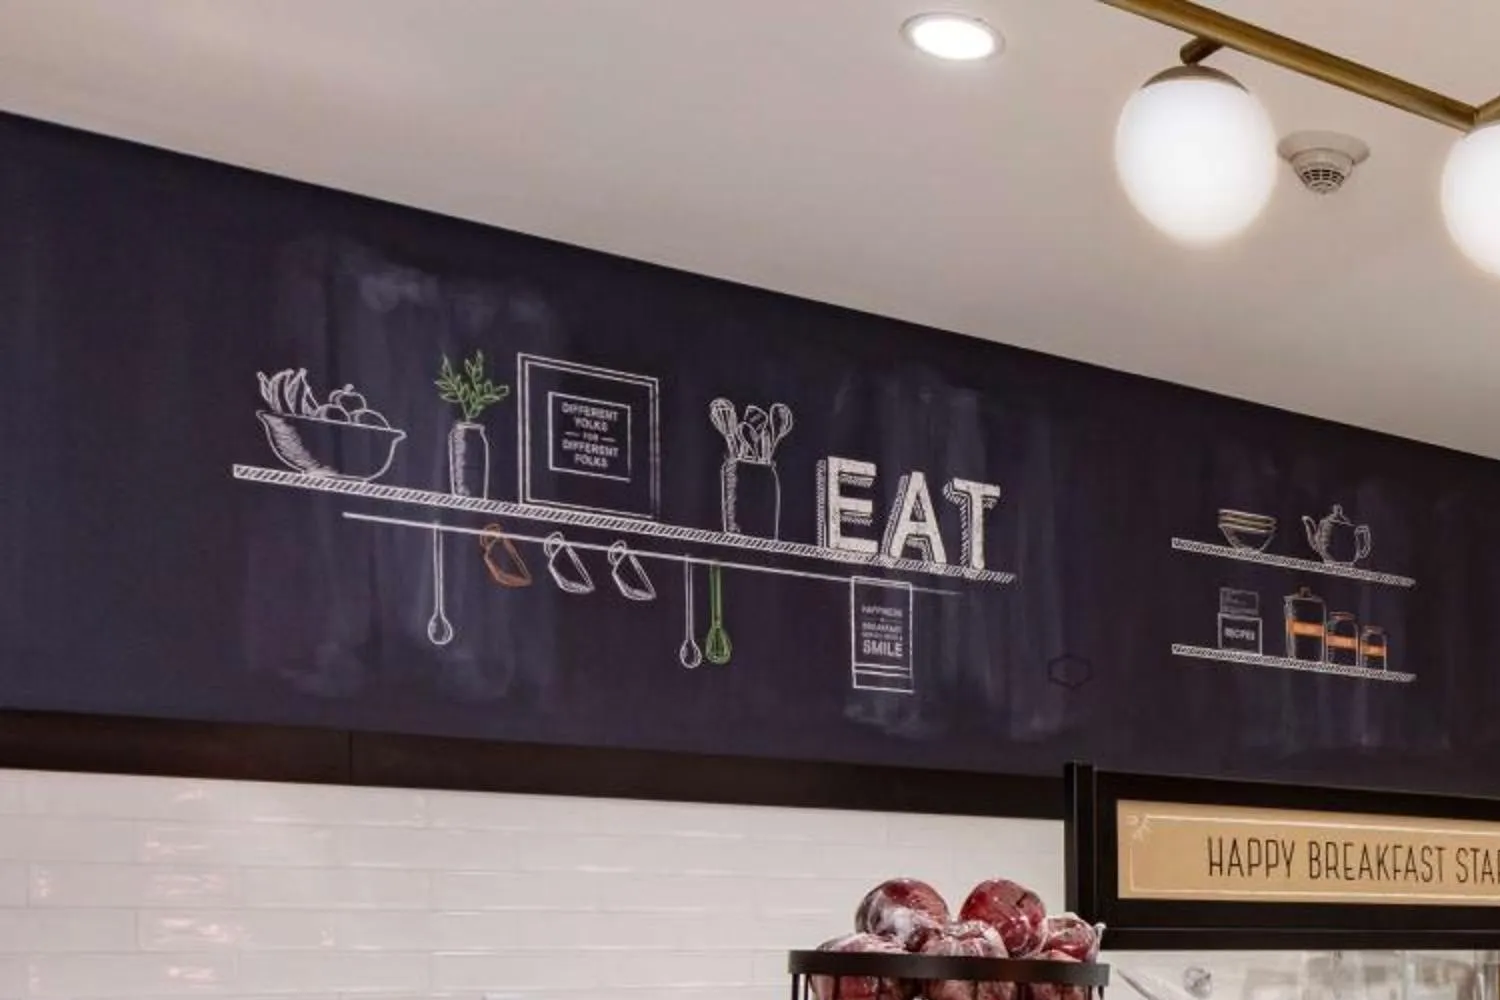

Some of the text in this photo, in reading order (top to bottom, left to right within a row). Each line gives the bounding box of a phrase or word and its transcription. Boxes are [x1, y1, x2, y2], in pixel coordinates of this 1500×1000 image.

[561, 402, 619, 421] DIFFERENT
[561, 439, 619, 457] DIFFERENT
[816, 455, 1001, 570] EAT
[862, 640, 903, 657] SMILE
[1206, 835, 1295, 880] HAPPY
[1308, 840, 1447, 884] BREAKFAST
